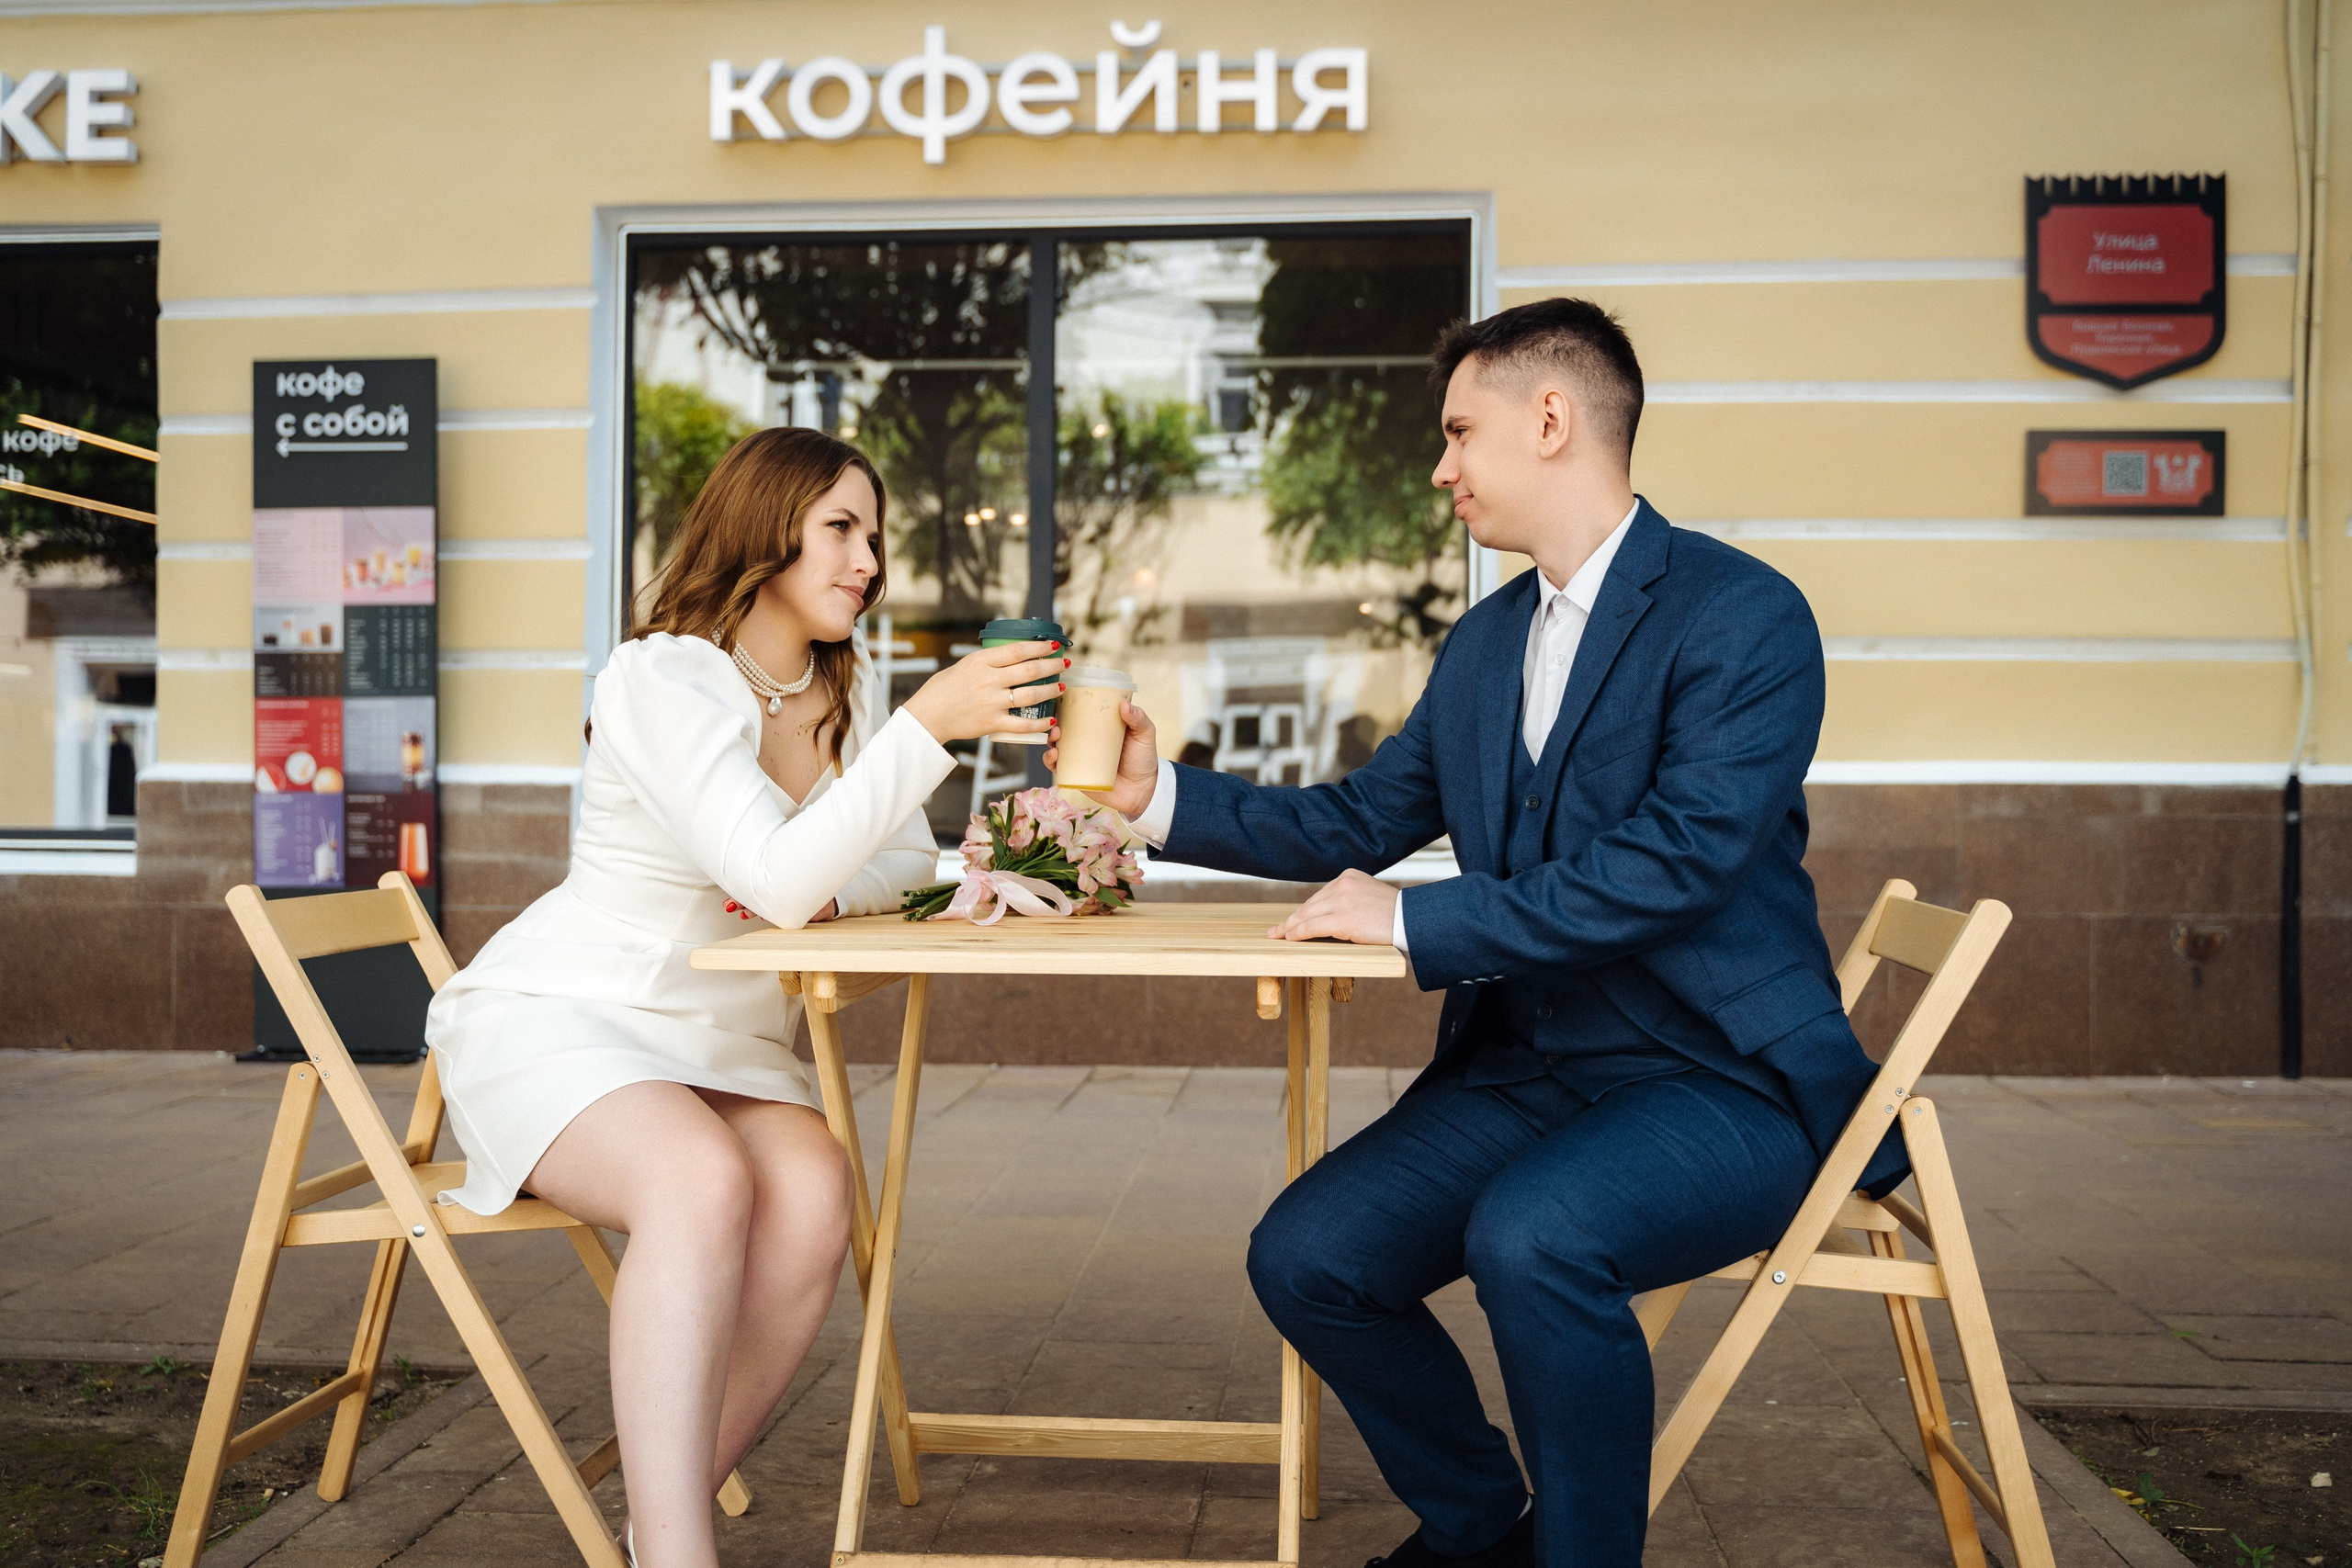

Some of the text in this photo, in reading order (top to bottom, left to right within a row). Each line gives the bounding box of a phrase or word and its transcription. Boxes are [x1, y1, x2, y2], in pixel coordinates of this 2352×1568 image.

[709, 20, 1368, 164] кофейня
[2092, 231, 2158, 254] Улица
[2086, 254, 2166, 275] Ленина
[277, 365, 365, 402] кофе
[276, 403, 409, 437] с собой
[2, 424, 80, 457] кофе
